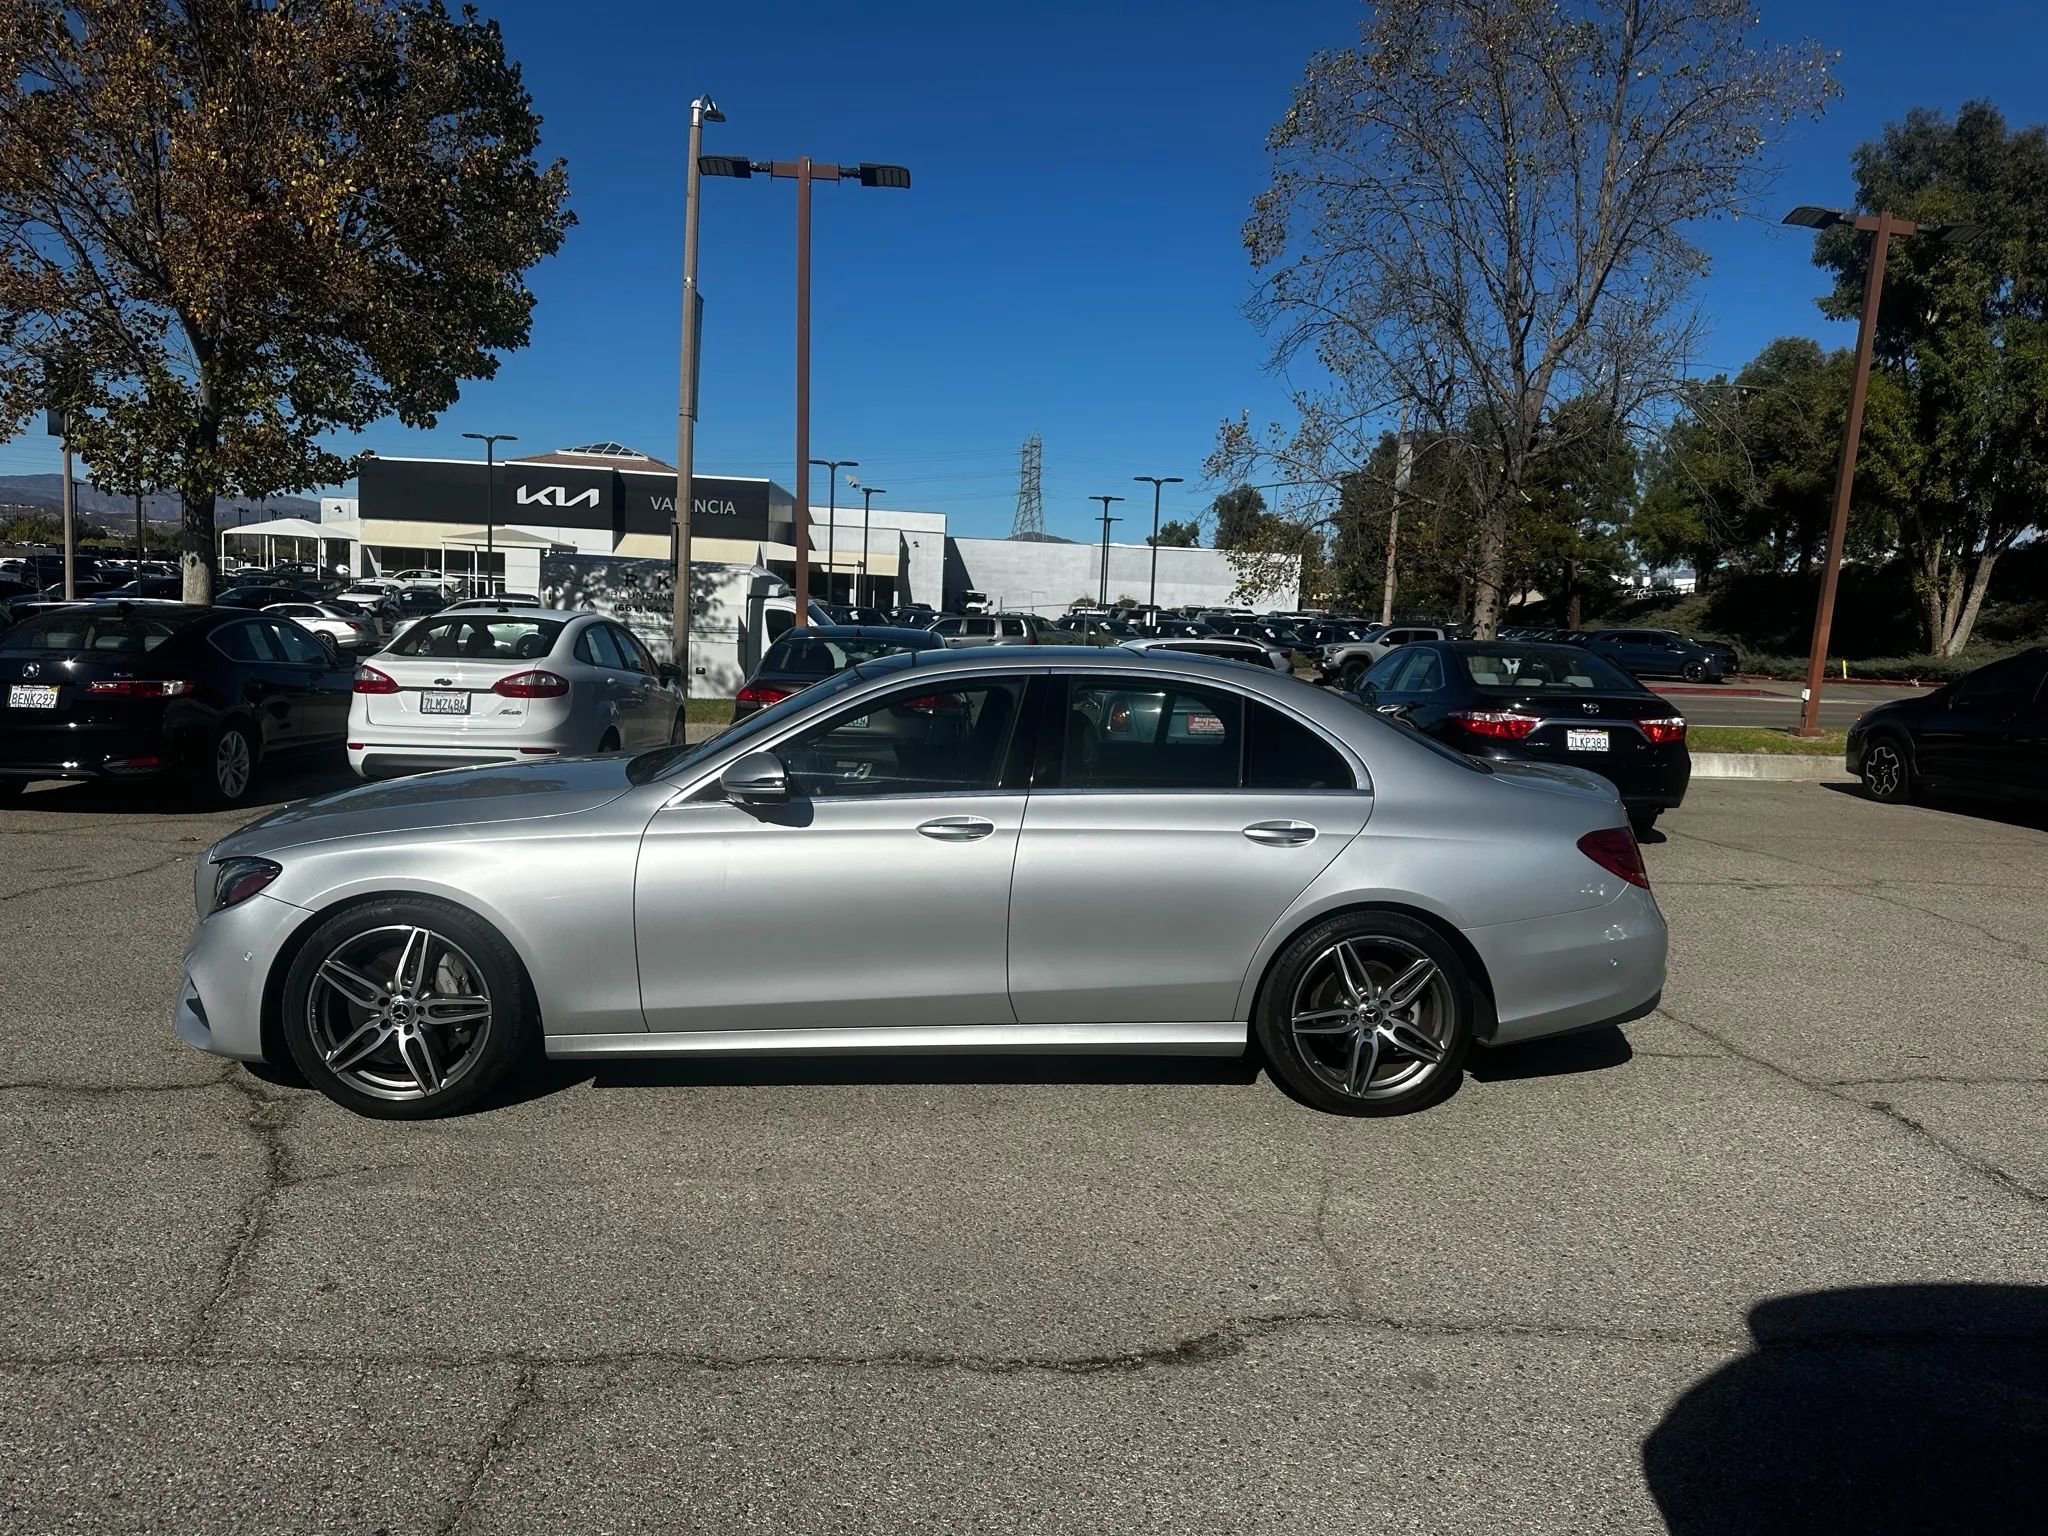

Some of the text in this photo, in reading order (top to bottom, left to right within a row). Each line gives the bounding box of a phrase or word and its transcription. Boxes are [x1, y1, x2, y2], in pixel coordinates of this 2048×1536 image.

[516, 484, 600, 509] KIA
[650, 496, 737, 515] VANCIA
[11, 692, 55, 705] 8ENK299
[424, 697, 465, 710] 7LMZ484
[1568, 736, 1607, 749] 7LKP383
